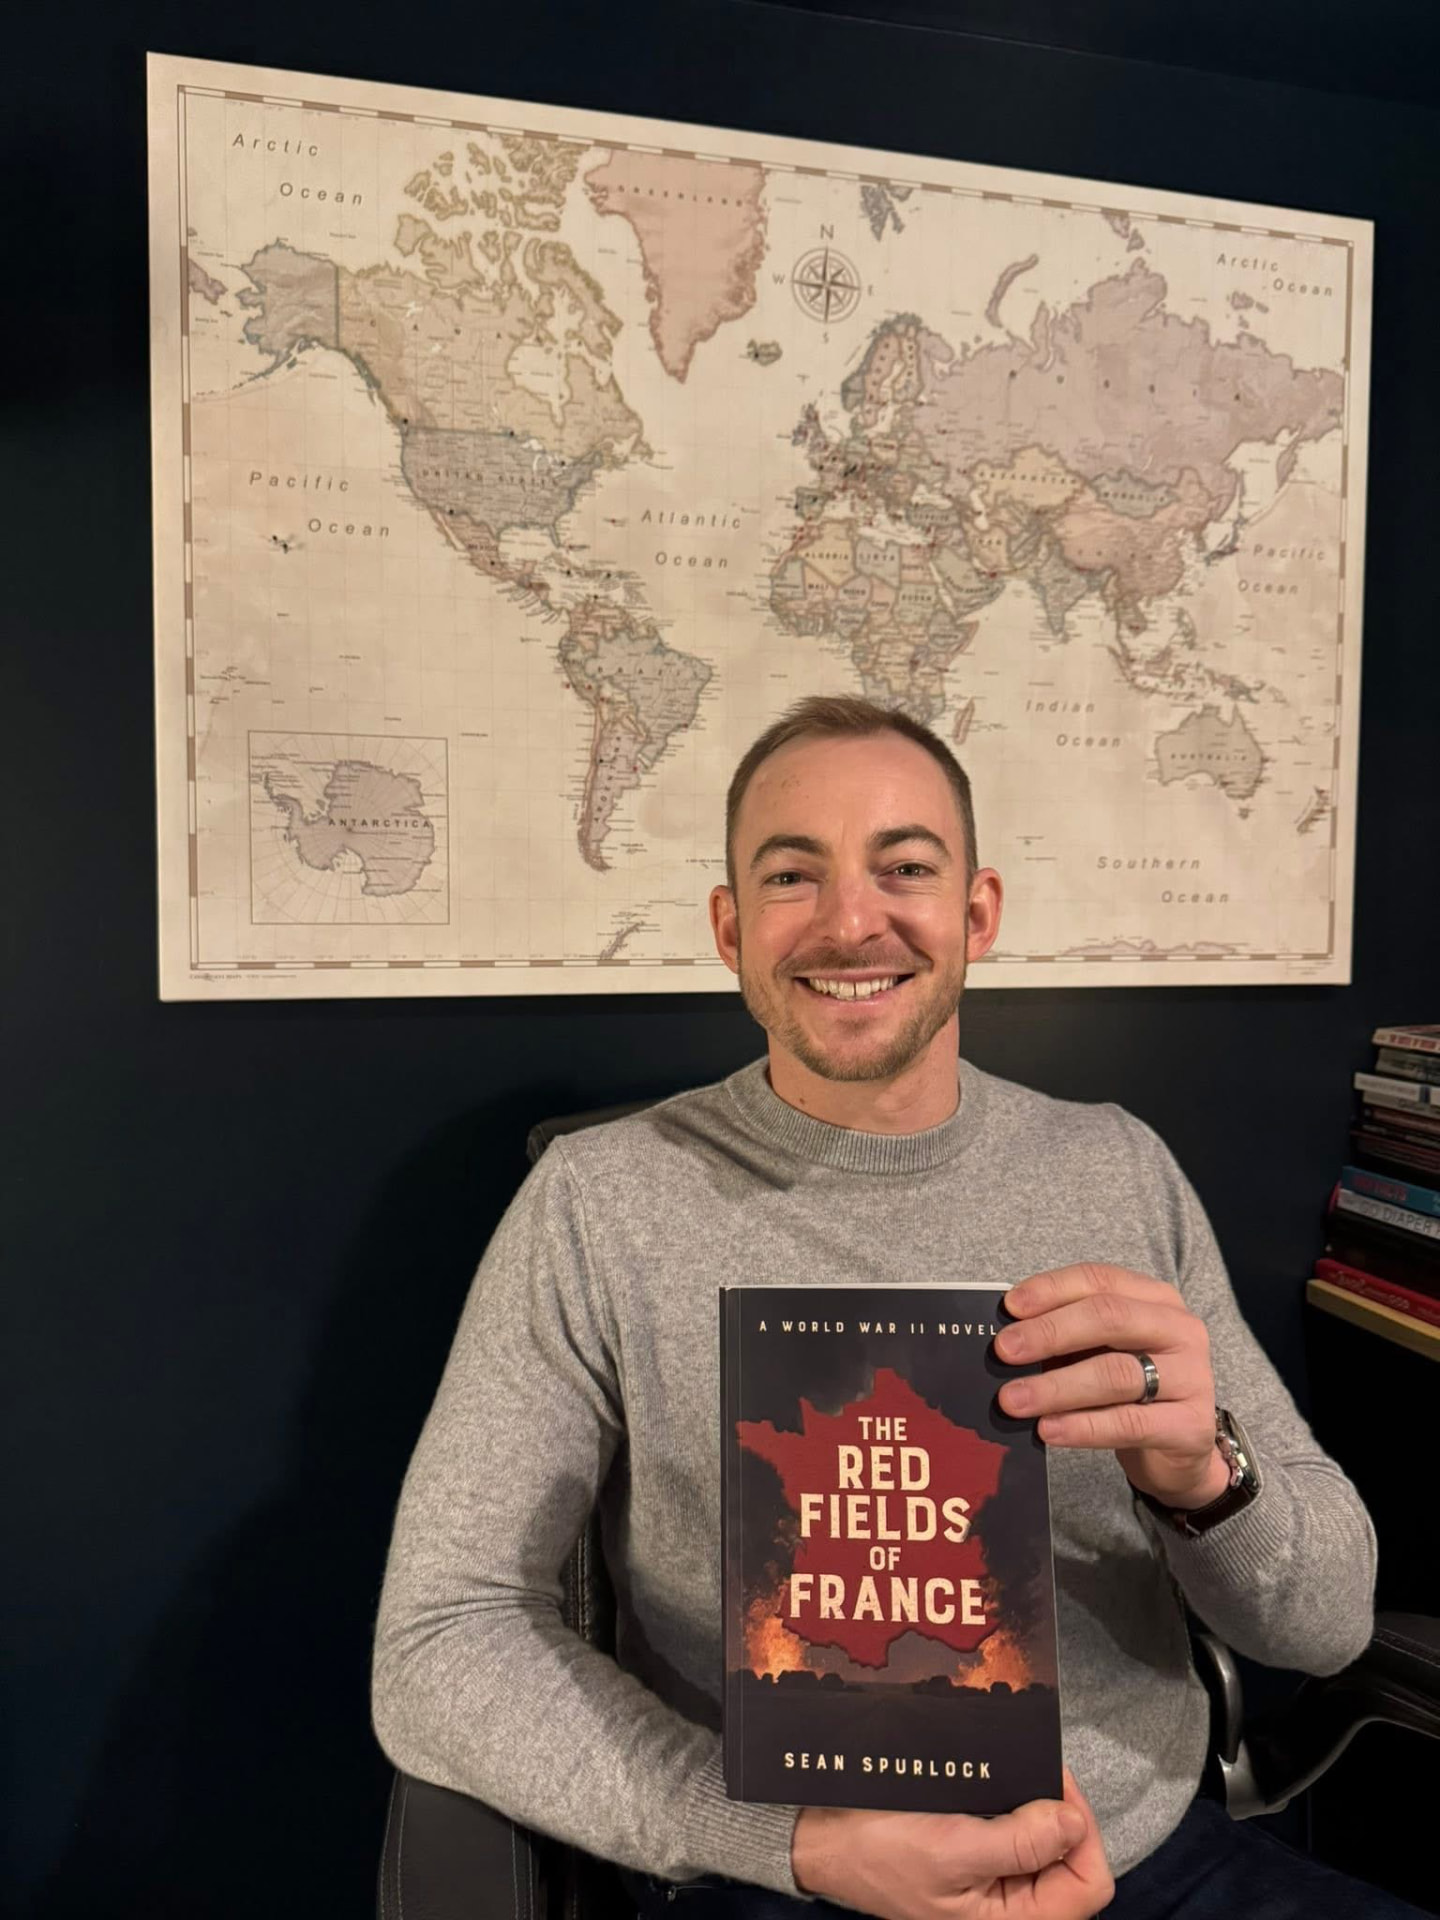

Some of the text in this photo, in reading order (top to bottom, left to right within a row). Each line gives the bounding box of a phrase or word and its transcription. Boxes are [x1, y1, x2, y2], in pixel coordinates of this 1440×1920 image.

[232, 133, 318, 157] Arctic
[279, 182, 363, 206] Ocean
[820, 224, 834, 240] N
[1217, 253, 1278, 272] Arctic
[772, 274, 786, 285] W
[1273, 278, 1333, 296] Ocean
[249, 470, 349, 492] Pacific
[308, 518, 389, 538] Ocean
[640, 509, 741, 529] Atlantic
[655, 551, 728, 568] Ocean
[1253, 543, 1325, 560] Pacific
[1238, 579, 1298, 594] Ocean
[1026, 699, 1095, 713] Indian
[1056, 733, 1121, 748] Ocean
[328, 818, 430, 828] ANTARCTICA
[1097, 856, 1200, 869] Southern
[1161, 890, 1229, 903] Ocean
[1383, 1206, 1432, 1234] DIAPER
[759, 1320, 997, 1336] A WORLD WAR II NOVEL
[858, 1416, 907, 1441] THE
[837, 1445, 931, 1491] RED
[800, 1493, 971, 1543] FIELDS
[869, 1546, 901, 1571] OF
[790, 1573, 986, 1625] FRANCE
[784, 1752, 991, 1779] SEAN SPURLOCK
